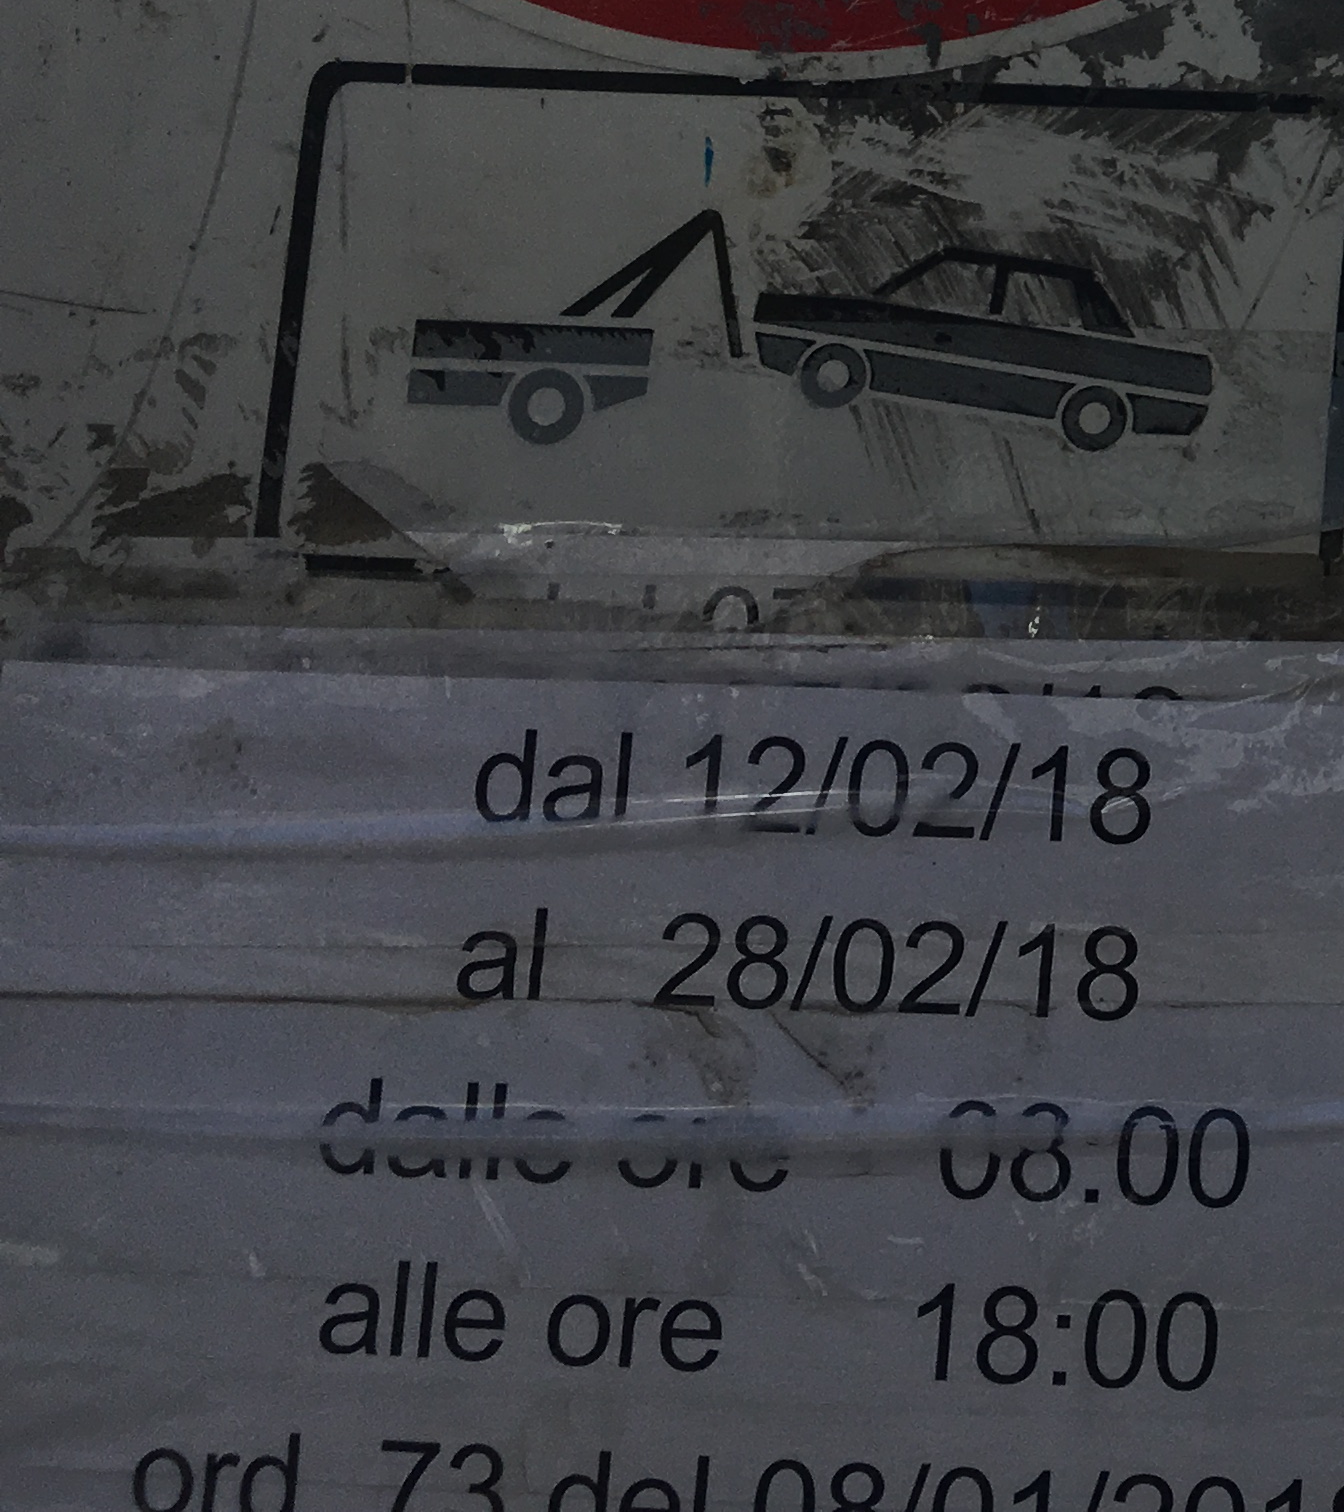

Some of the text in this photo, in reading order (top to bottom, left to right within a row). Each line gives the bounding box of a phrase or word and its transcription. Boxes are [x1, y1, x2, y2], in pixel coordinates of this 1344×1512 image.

[475, 729, 1151, 845] dal 12/02/18
[455, 907, 1138, 1025] al 28/02/18
[319, 1260, 1218, 1391] alle ore 18:00
[134, 1435, 302, 1512] ord
[379, 1439, 506, 1512] 73
